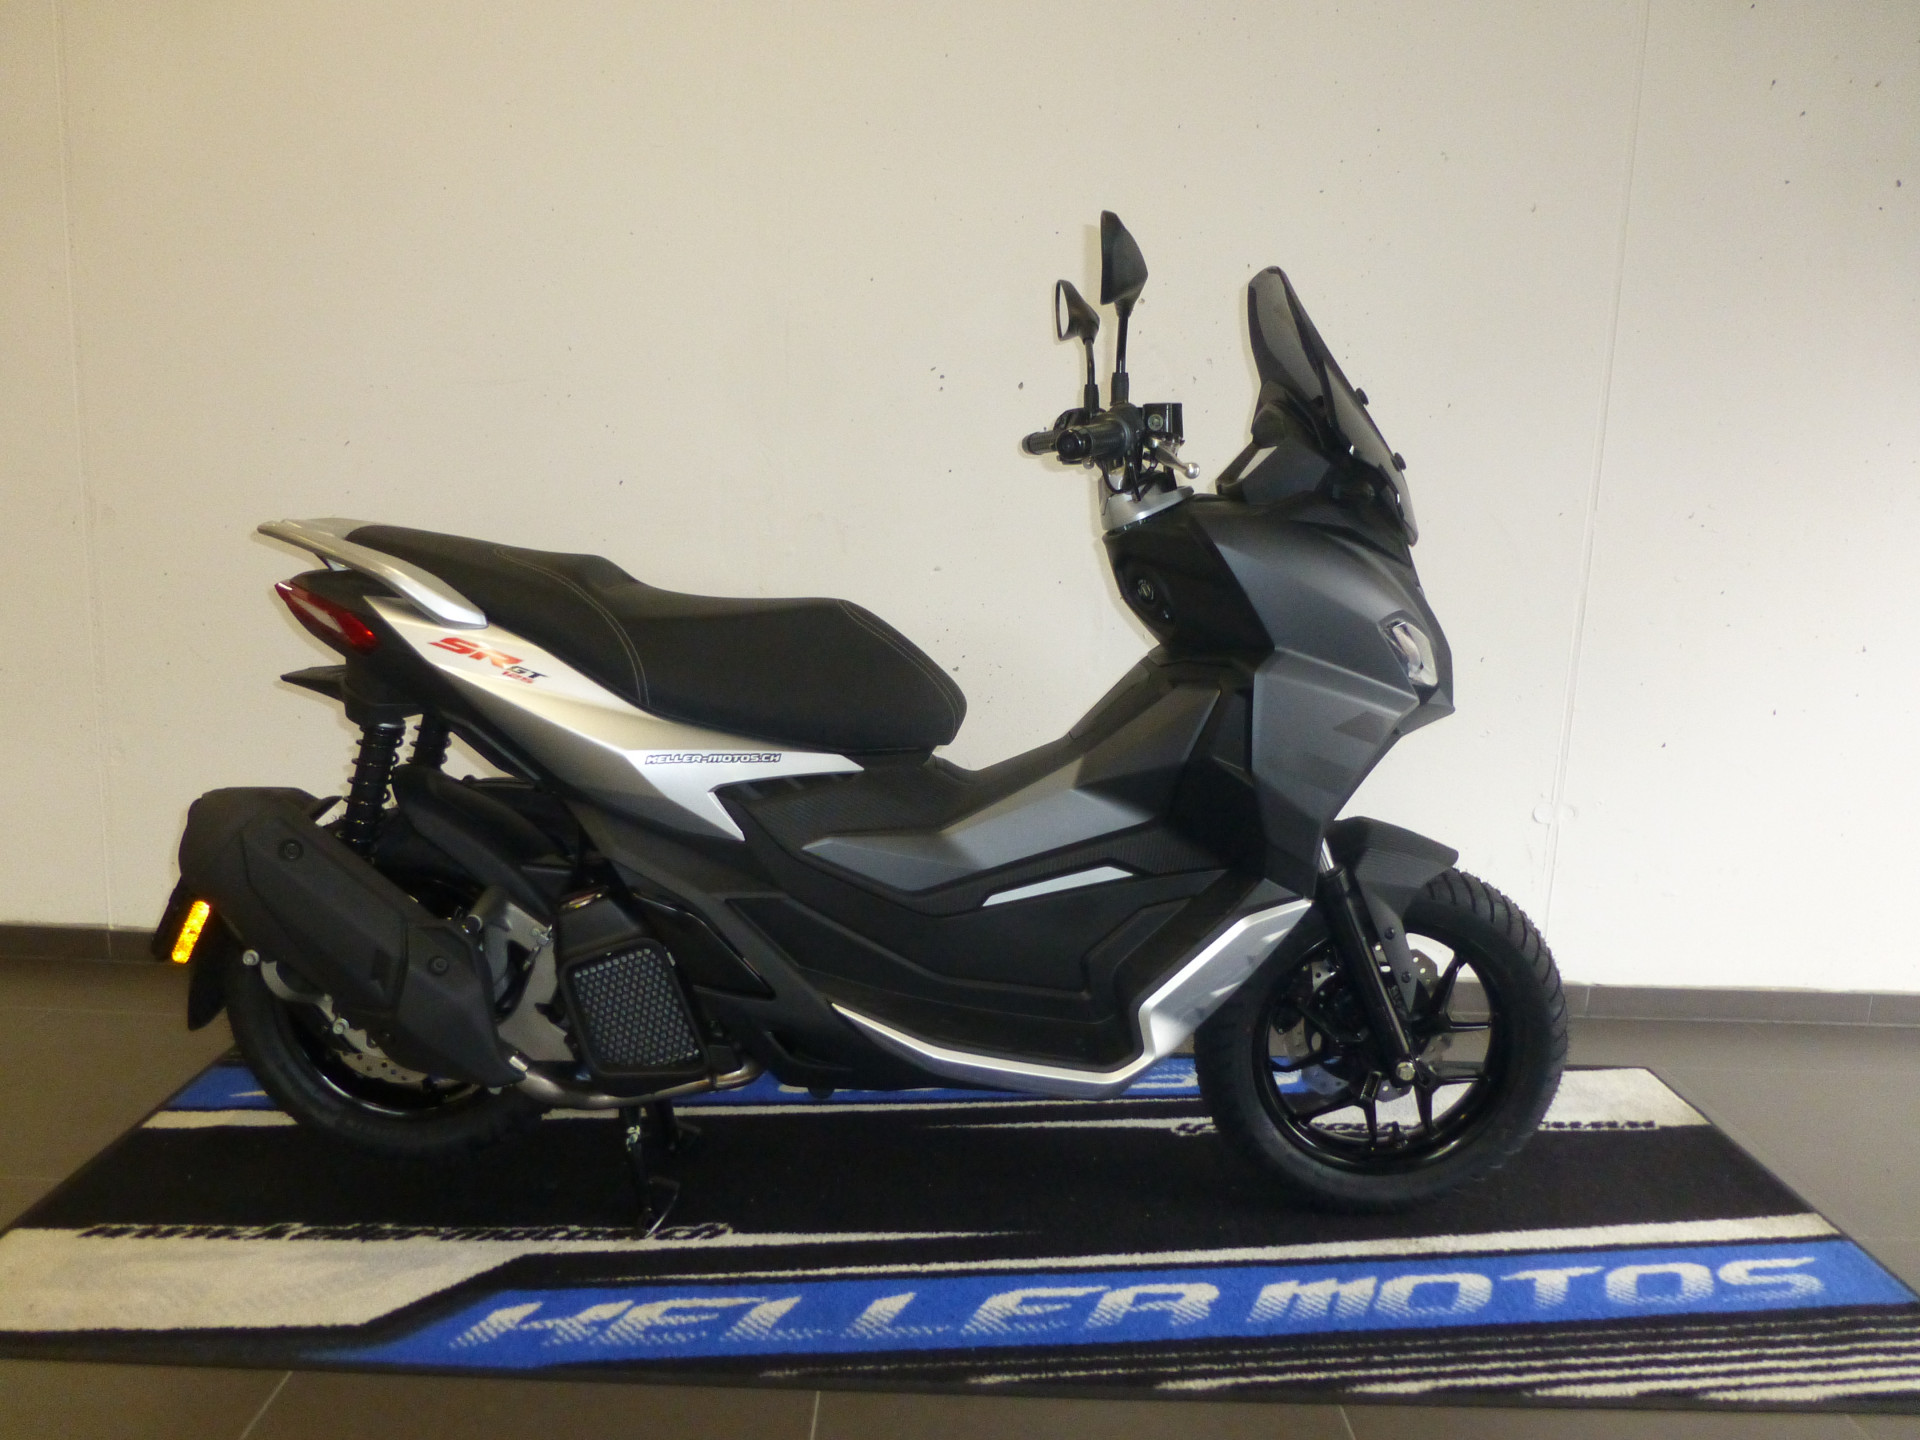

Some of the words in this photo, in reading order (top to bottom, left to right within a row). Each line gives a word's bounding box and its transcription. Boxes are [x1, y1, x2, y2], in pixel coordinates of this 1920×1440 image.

[429, 637, 524, 669] SR
[505, 665, 549, 679] GT
[644, 752, 782, 765] KELLER-MOTOS.CH
[1246, 1255, 1826, 1324] MOTOS
